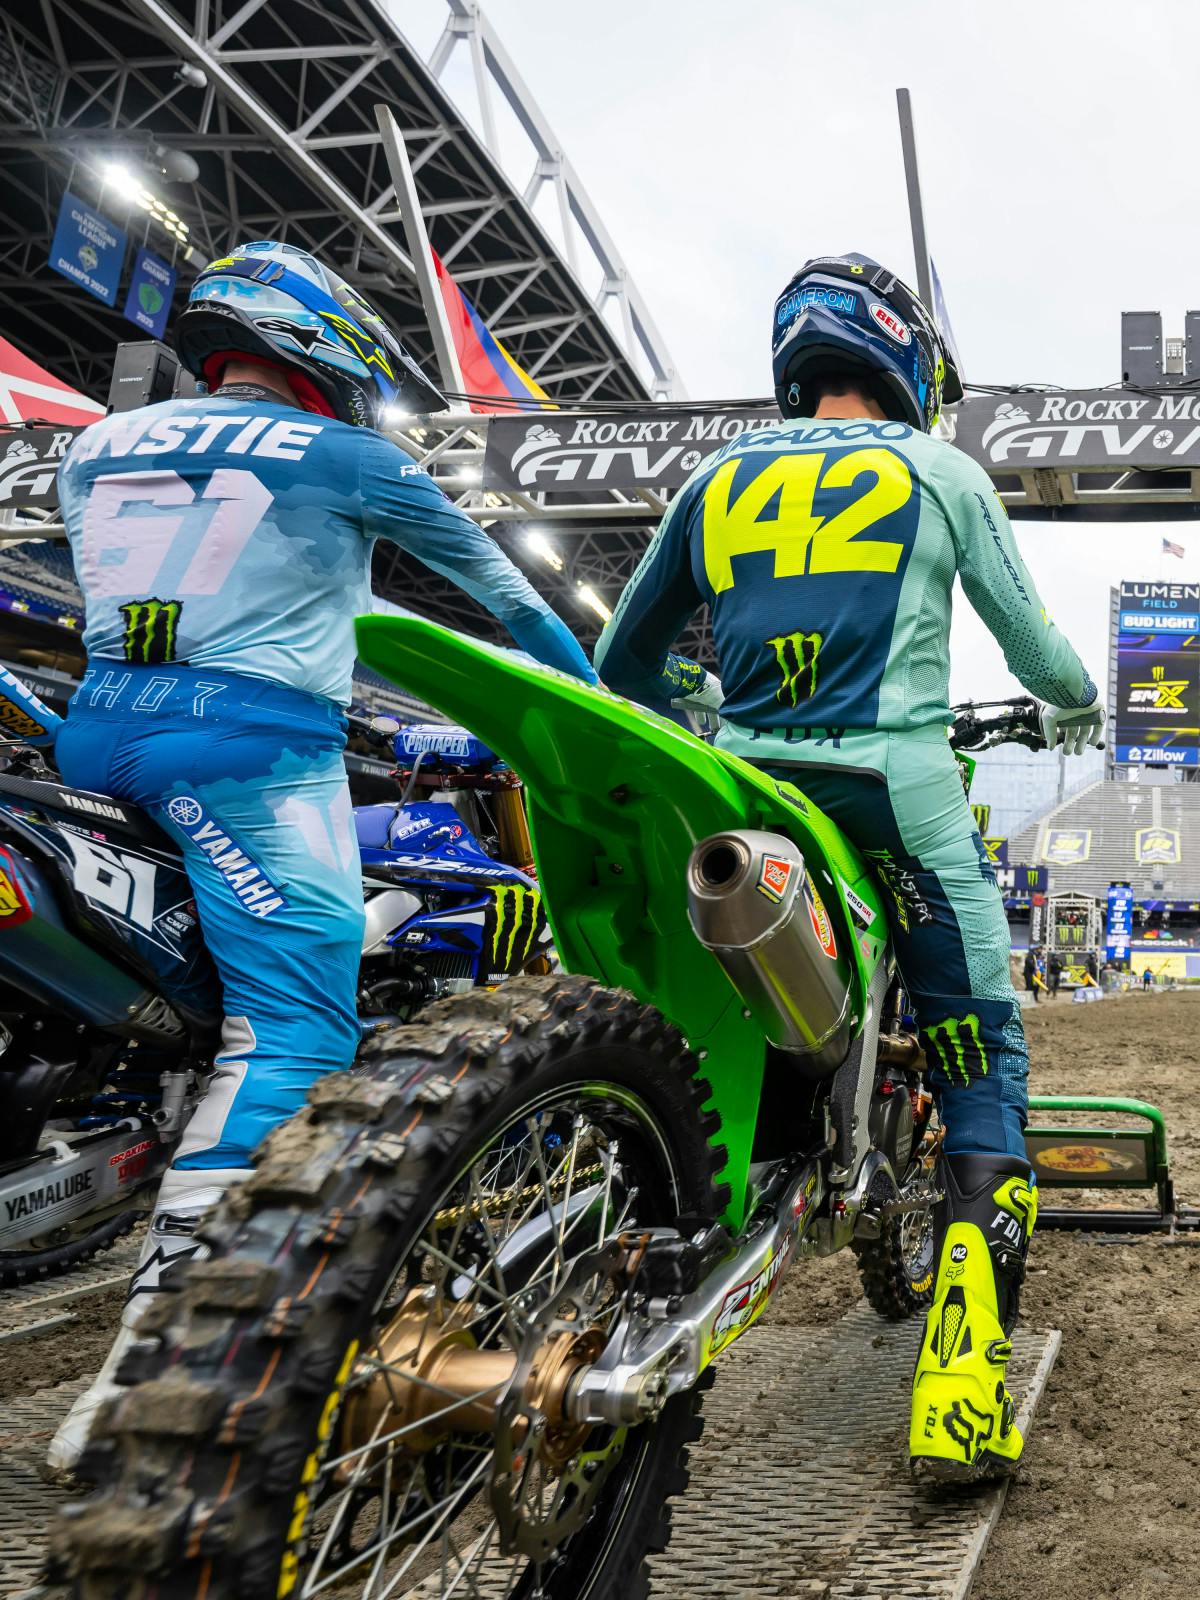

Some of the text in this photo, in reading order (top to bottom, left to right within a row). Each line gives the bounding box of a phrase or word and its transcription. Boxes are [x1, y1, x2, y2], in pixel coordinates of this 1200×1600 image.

[777, 288, 857, 325] CAMERON
[875, 308, 907, 341] BELL
[1036, 397, 1151, 422] ROCKY
[567, 419, 679, 445] ROCKY
[518, 446, 686, 486] ATV
[82, 469, 275, 597] 61
[703, 448, 913, 596] 142
[974, 492, 1032, 606] PRO CIRCUIT
[1121, 583, 1200, 600] LUMEN
[1142, 599, 1178, 609] FIELD
[1123, 614, 1197, 629] BUD LIGHT
[1128, 684, 1186, 708] SMX
[405, 734, 468, 755] PROTAPER
[1143, 748, 1187, 762] Zillow
[59, 792, 130, 823] YAMAHA
[58, 827, 158, 933] 61
[191, 820, 286, 918] YAMAHA
[1130, 938, 1189, 948] eacock
[5, 1168, 97, 1221] YAMALUBE
[990, 1211, 1022, 1248] FOX
[952, 1246, 967, 1260] 142
[924, 1404, 938, 1439] FOX
